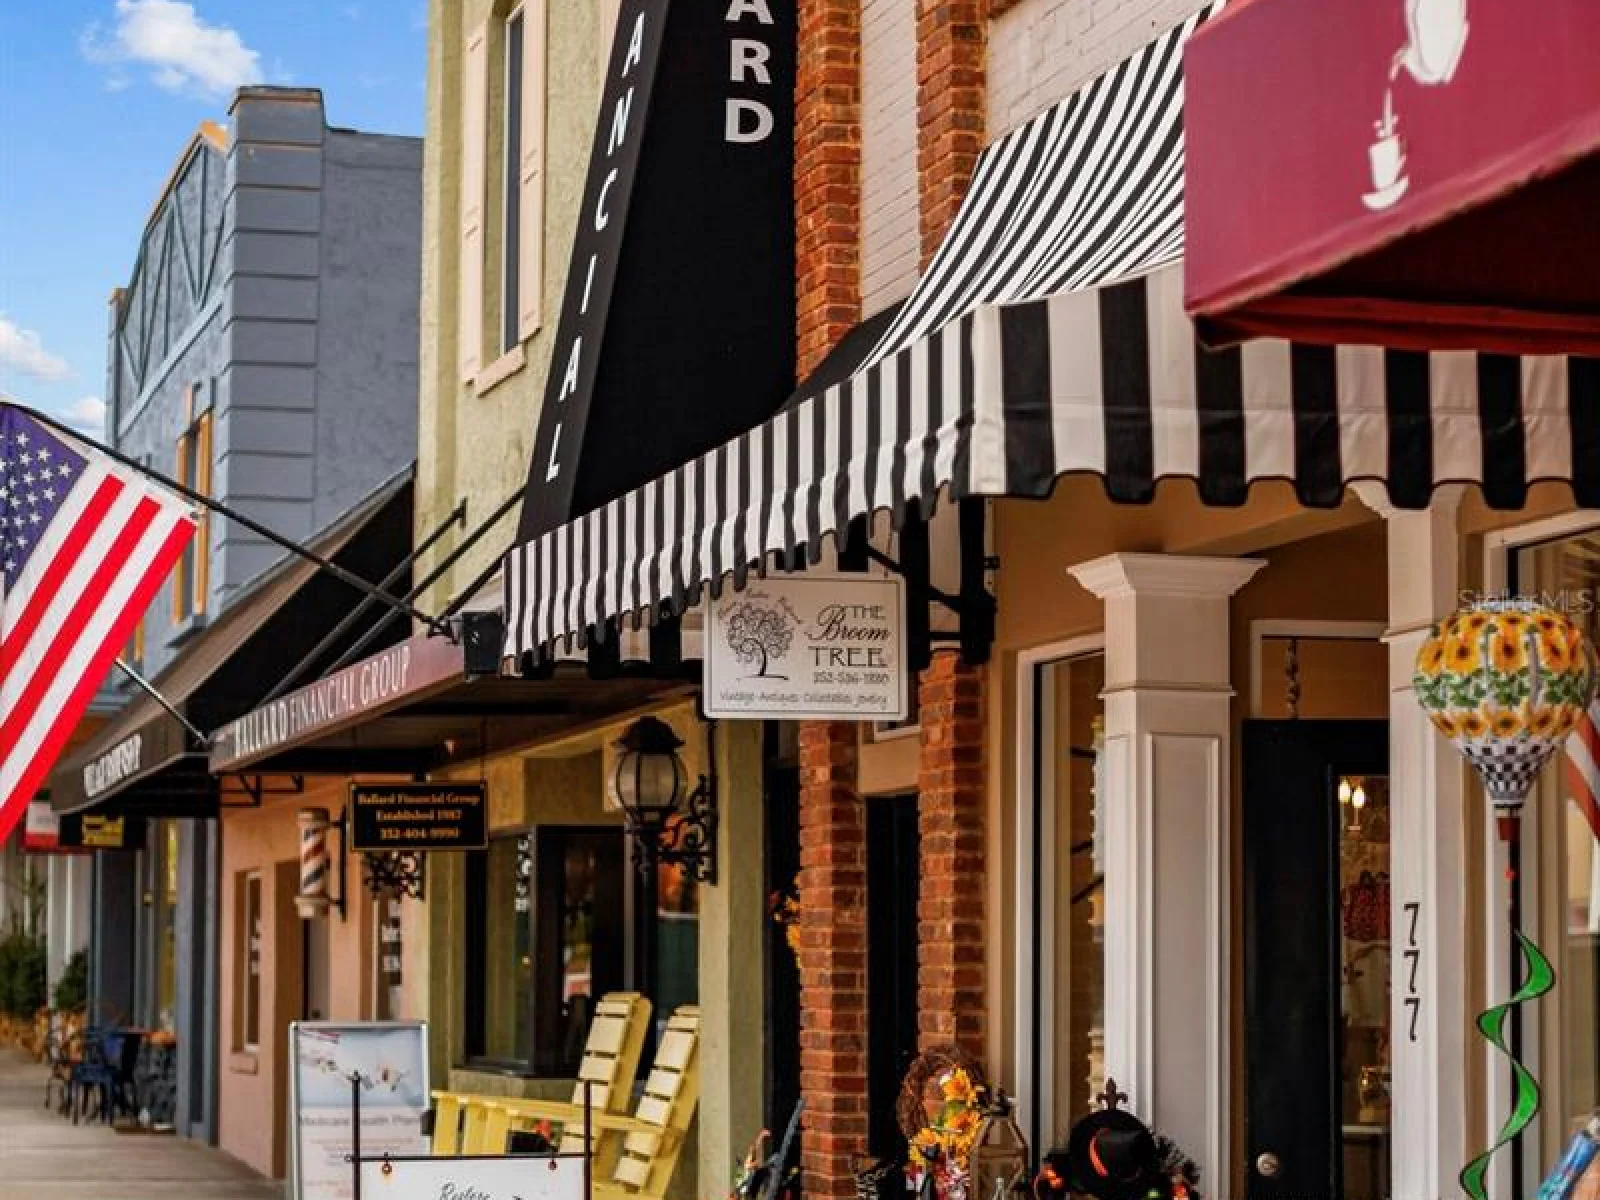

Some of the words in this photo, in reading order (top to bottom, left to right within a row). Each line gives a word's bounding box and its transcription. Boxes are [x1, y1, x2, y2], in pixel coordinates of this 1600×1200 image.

[545, 10, 645, 483] ANCIAL
[803, 604, 890, 641] Broom
[847, 604, 887, 621] THE
[808, 645, 887, 668] TREE
[289, 671, 355, 735] FINANCIAL
[359, 645, 411, 706] GROUP
[1403, 902, 1421, 1042] 777
